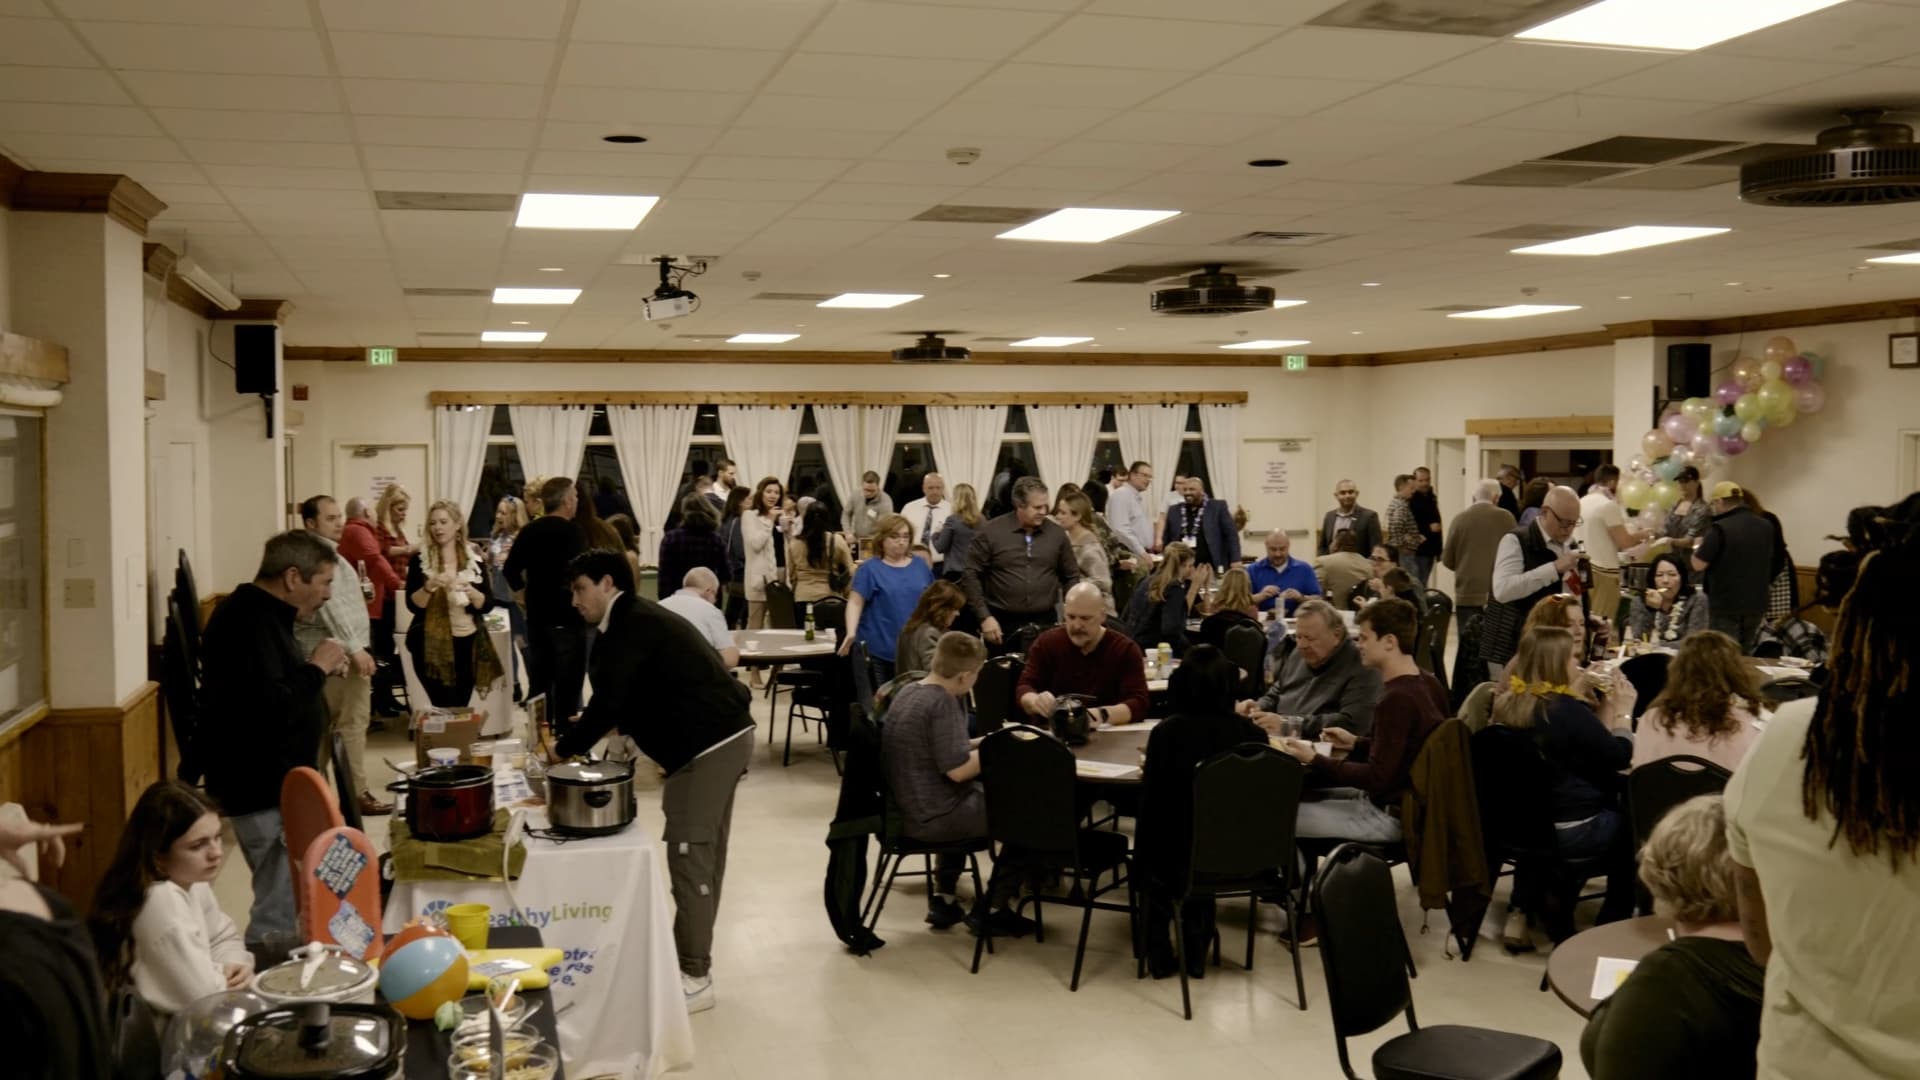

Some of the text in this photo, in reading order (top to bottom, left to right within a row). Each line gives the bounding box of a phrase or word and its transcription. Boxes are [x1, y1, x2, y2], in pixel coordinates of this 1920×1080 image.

[371, 349, 393, 365] EXIT
[1287, 356, 1304, 370] EXIT
[488, 902, 613, 928] ealthyLiving
